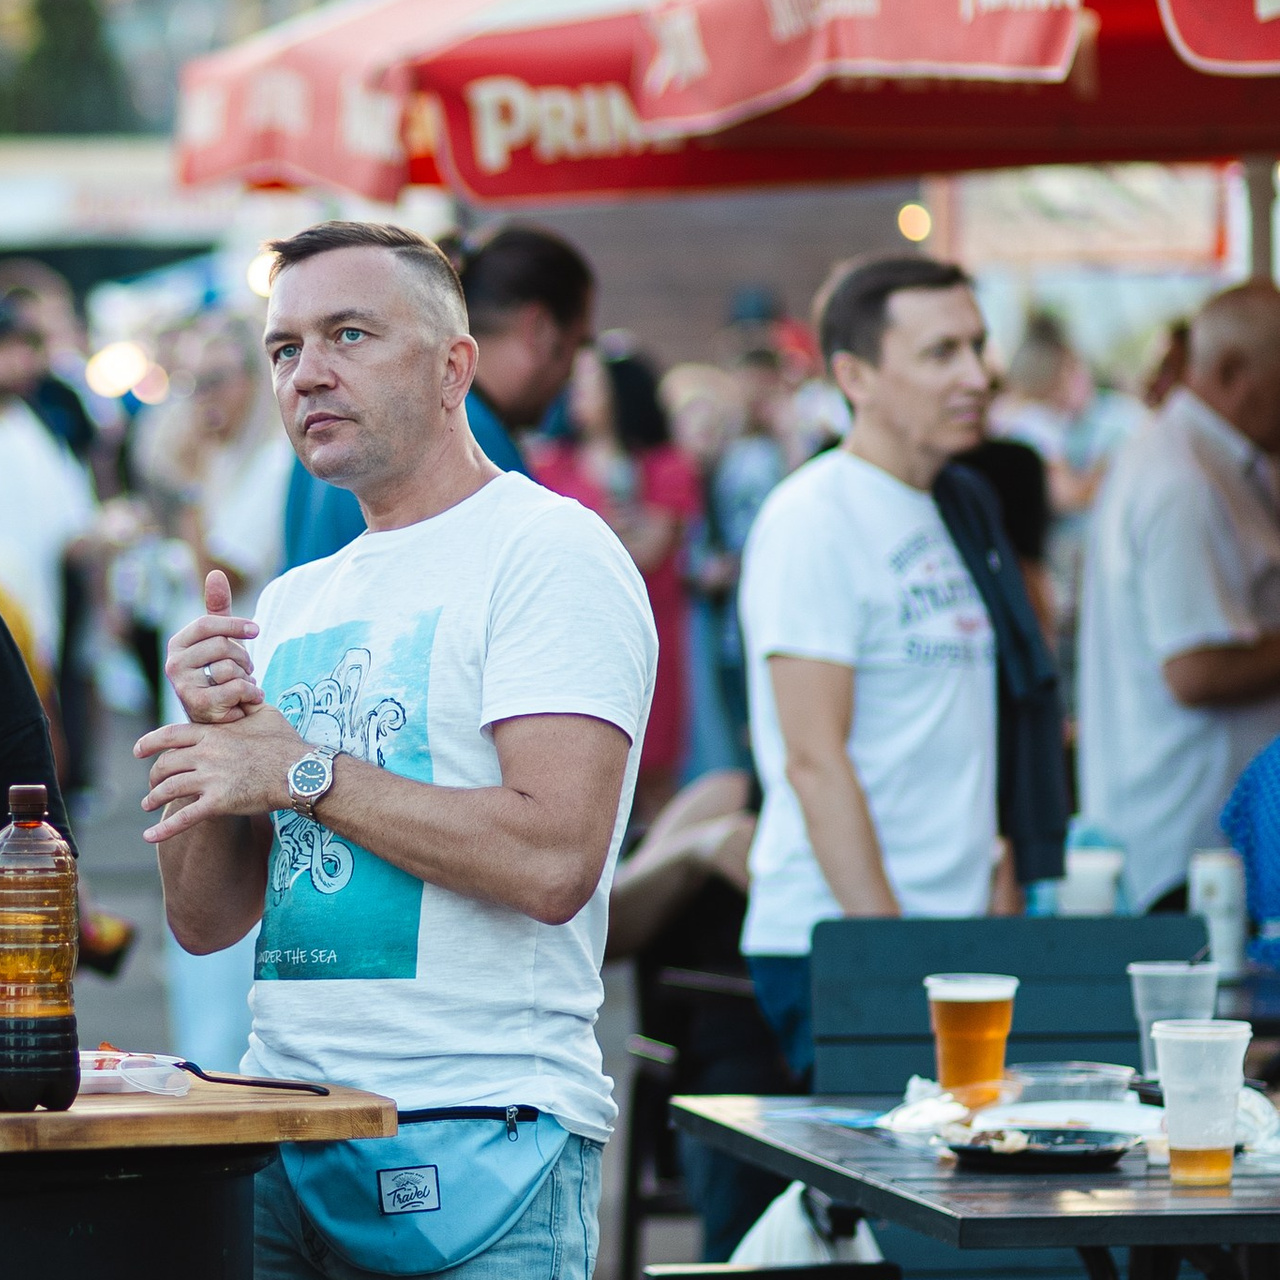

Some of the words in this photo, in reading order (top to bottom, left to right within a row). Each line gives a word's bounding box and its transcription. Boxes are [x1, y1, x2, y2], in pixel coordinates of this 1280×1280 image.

[283, 947, 308, 965] THE
[310, 948, 337, 964] SEA
[387, 1185, 431, 1208] Travel
